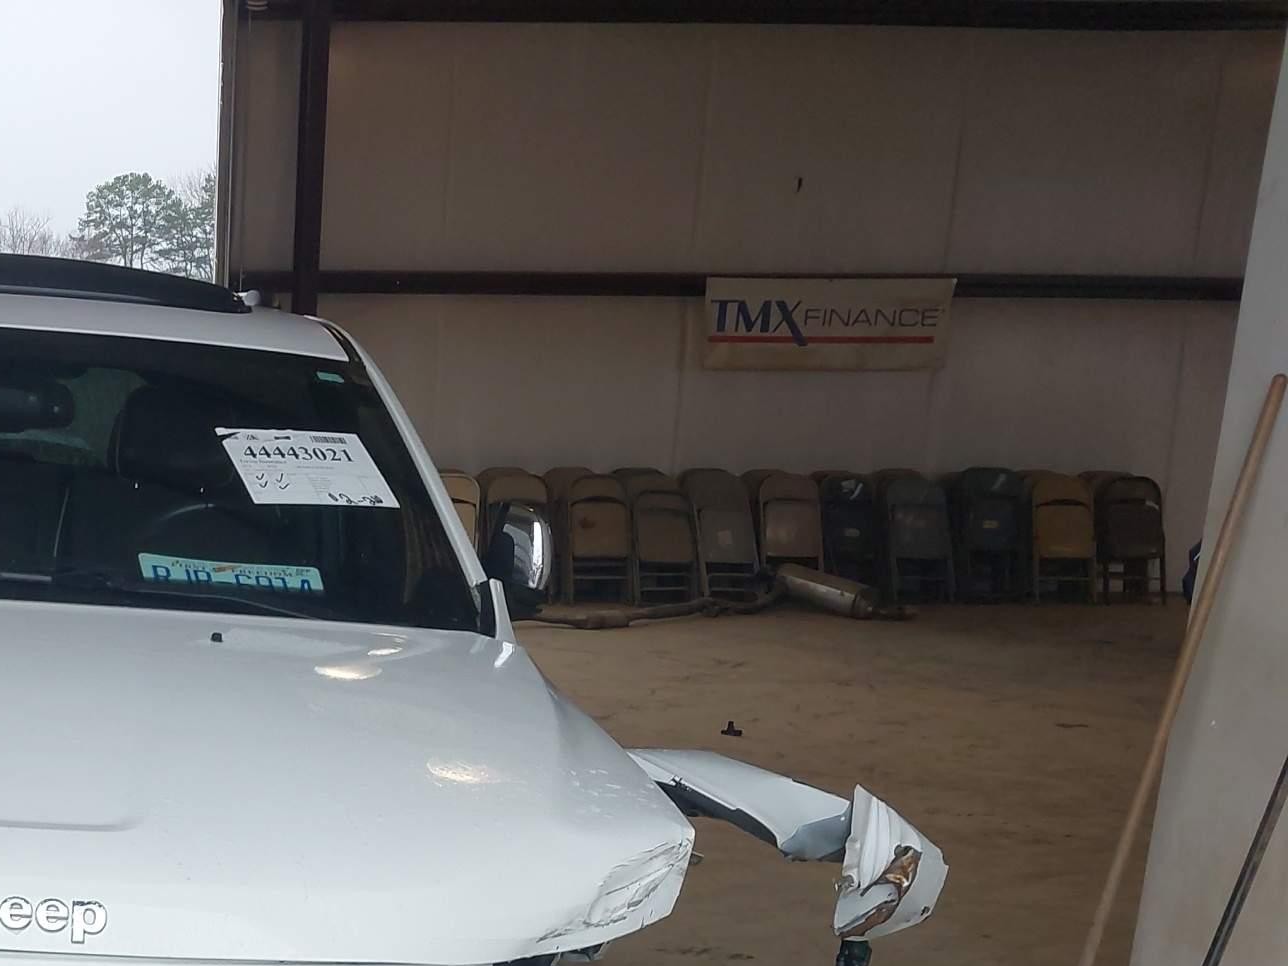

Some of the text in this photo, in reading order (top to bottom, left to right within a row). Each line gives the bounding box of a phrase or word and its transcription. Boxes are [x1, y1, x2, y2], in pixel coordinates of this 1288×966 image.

[711, 299, 937, 347] TMX FINANCE
[244, 446, 354, 463] 44443021
